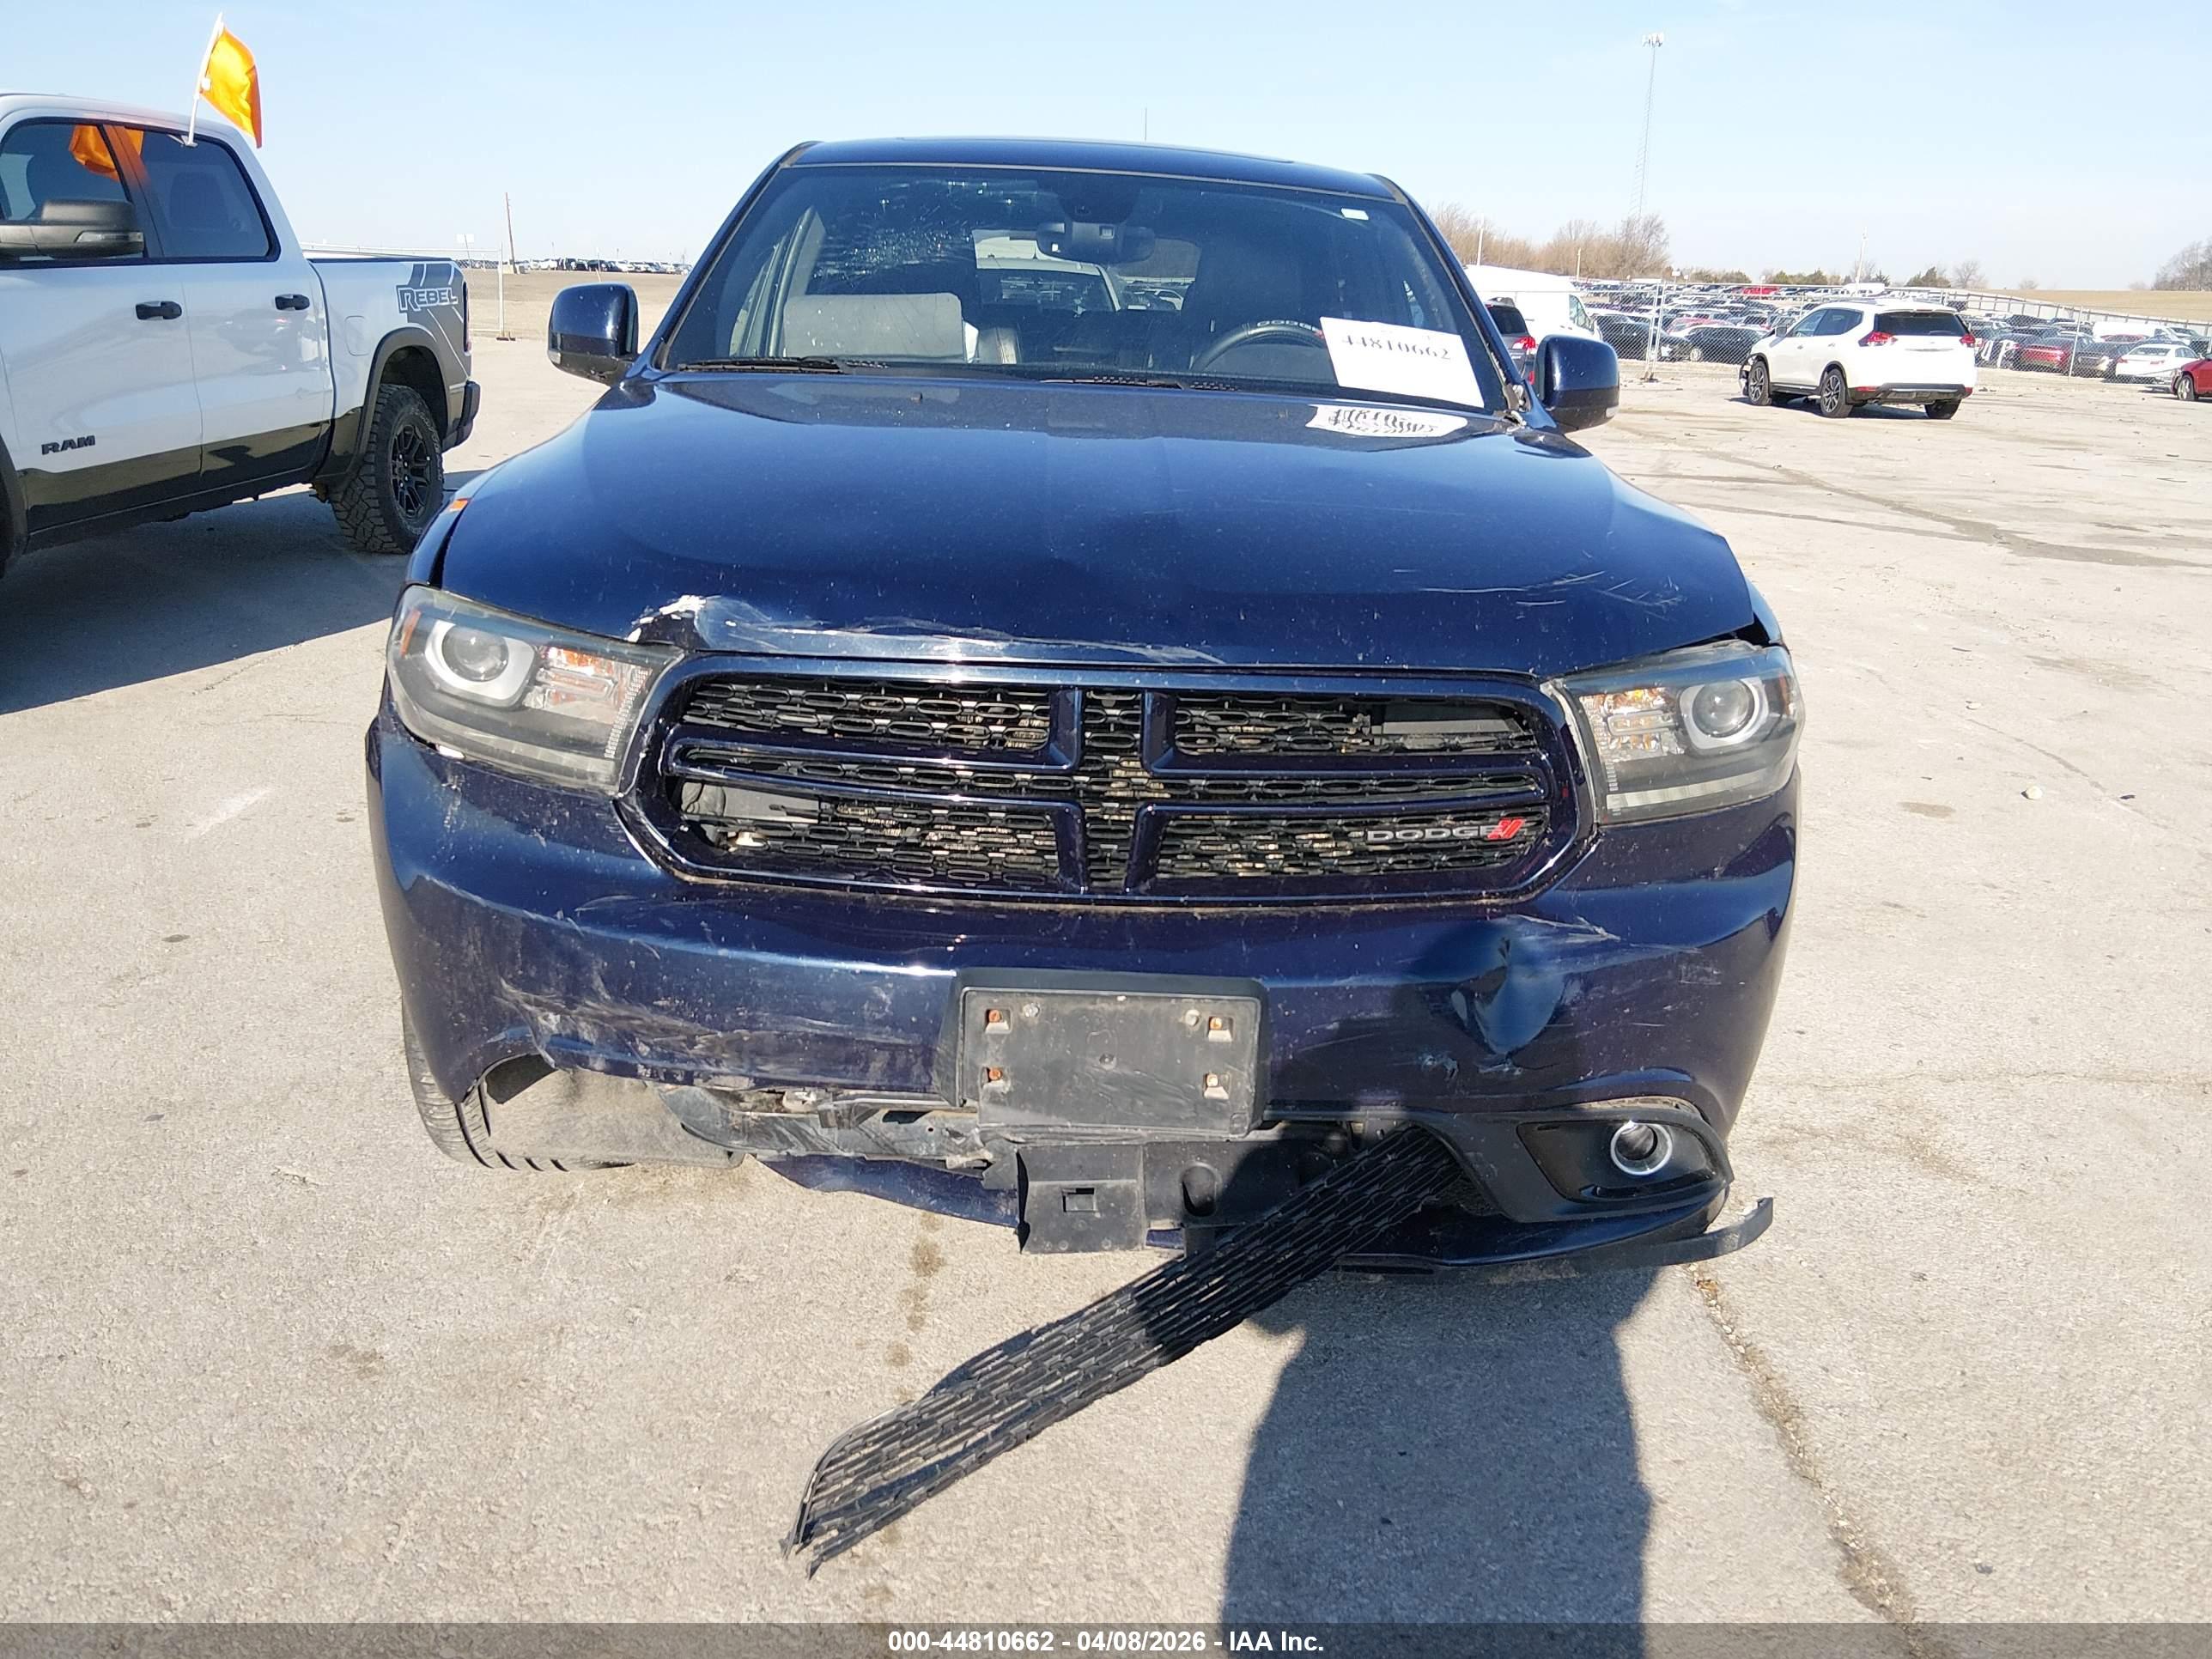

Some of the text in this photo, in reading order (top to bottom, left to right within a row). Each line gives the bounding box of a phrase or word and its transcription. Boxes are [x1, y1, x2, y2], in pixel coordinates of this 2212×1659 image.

[398, 287, 459, 312] REBEL
[41, 434, 95, 455] RAM
[1367, 824, 1499, 842] DODGE
